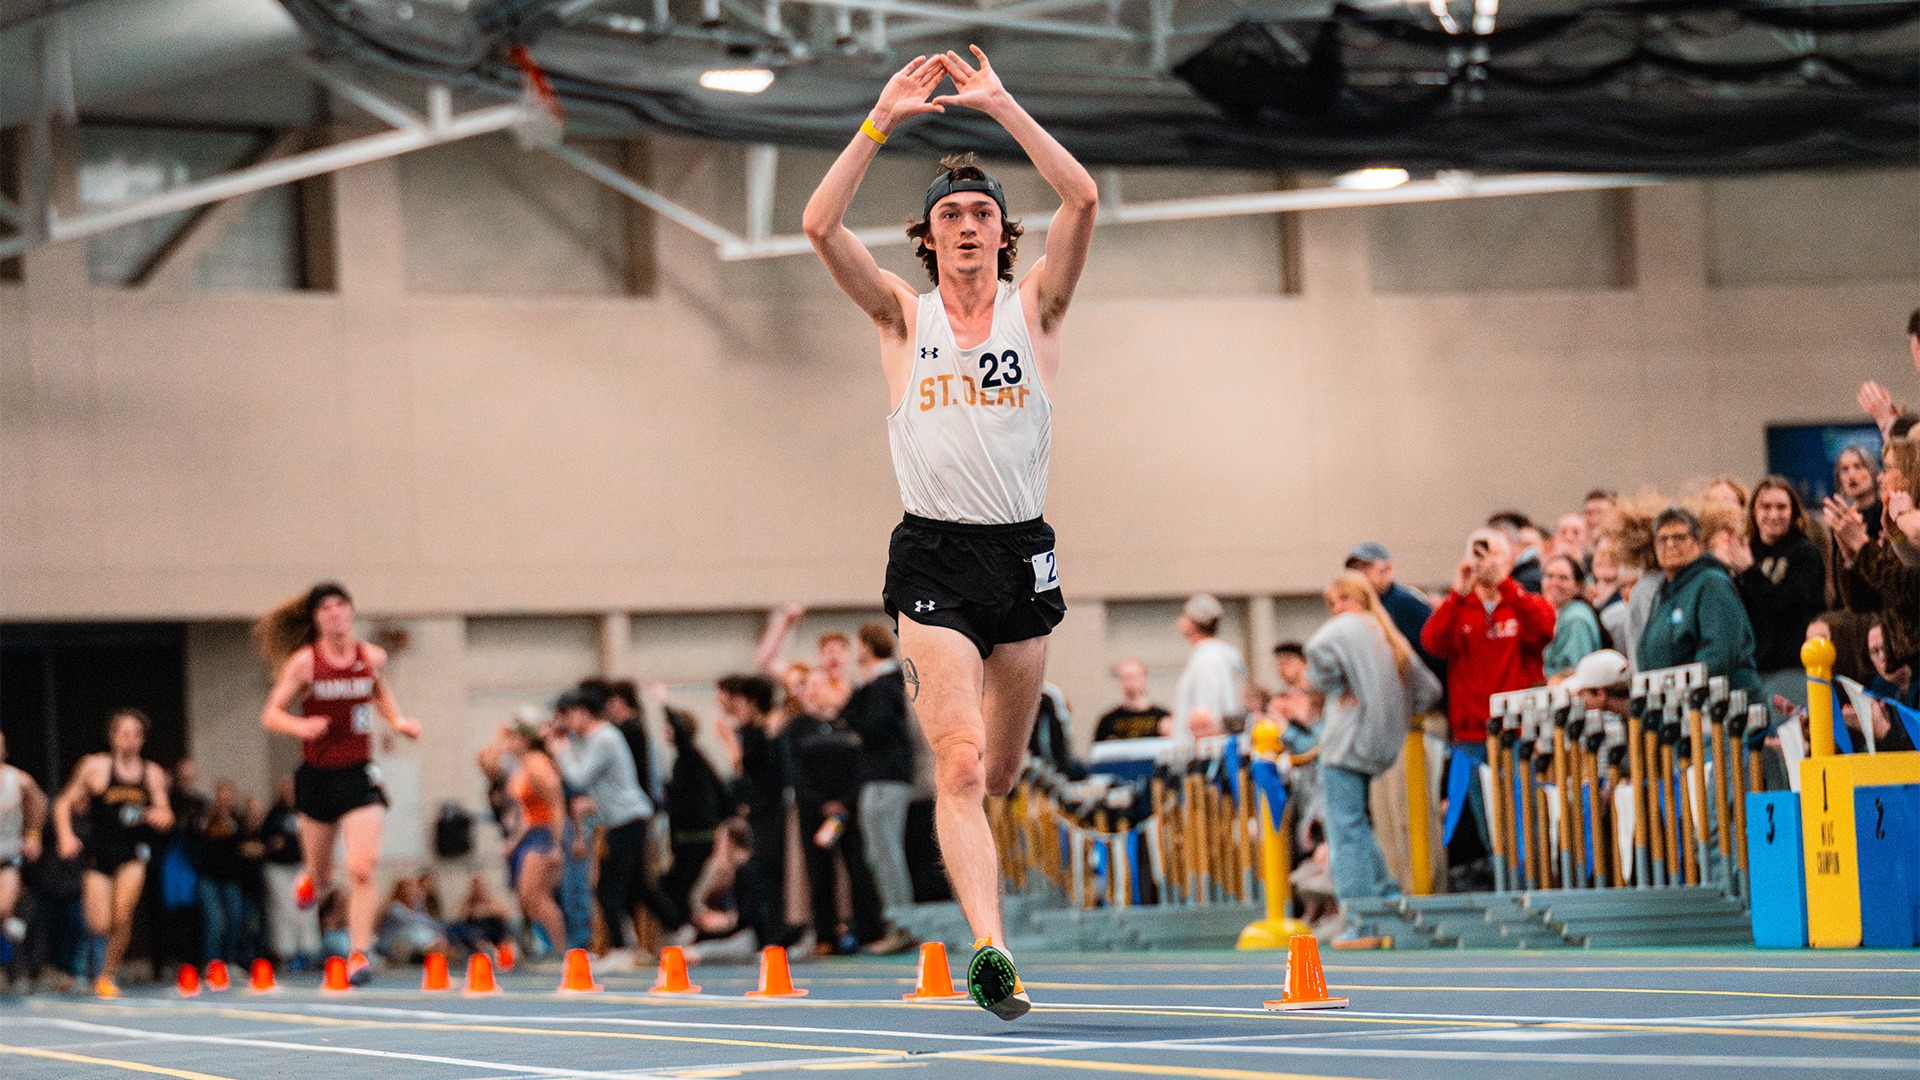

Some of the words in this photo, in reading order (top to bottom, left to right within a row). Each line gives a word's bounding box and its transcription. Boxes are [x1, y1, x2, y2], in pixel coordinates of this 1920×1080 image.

[979, 349, 1022, 388] 23
[919, 374, 958, 412] ST.
[1822, 768, 1828, 813] 1
[1766, 802, 1775, 844] 3
[1875, 796, 1885, 840] 2
